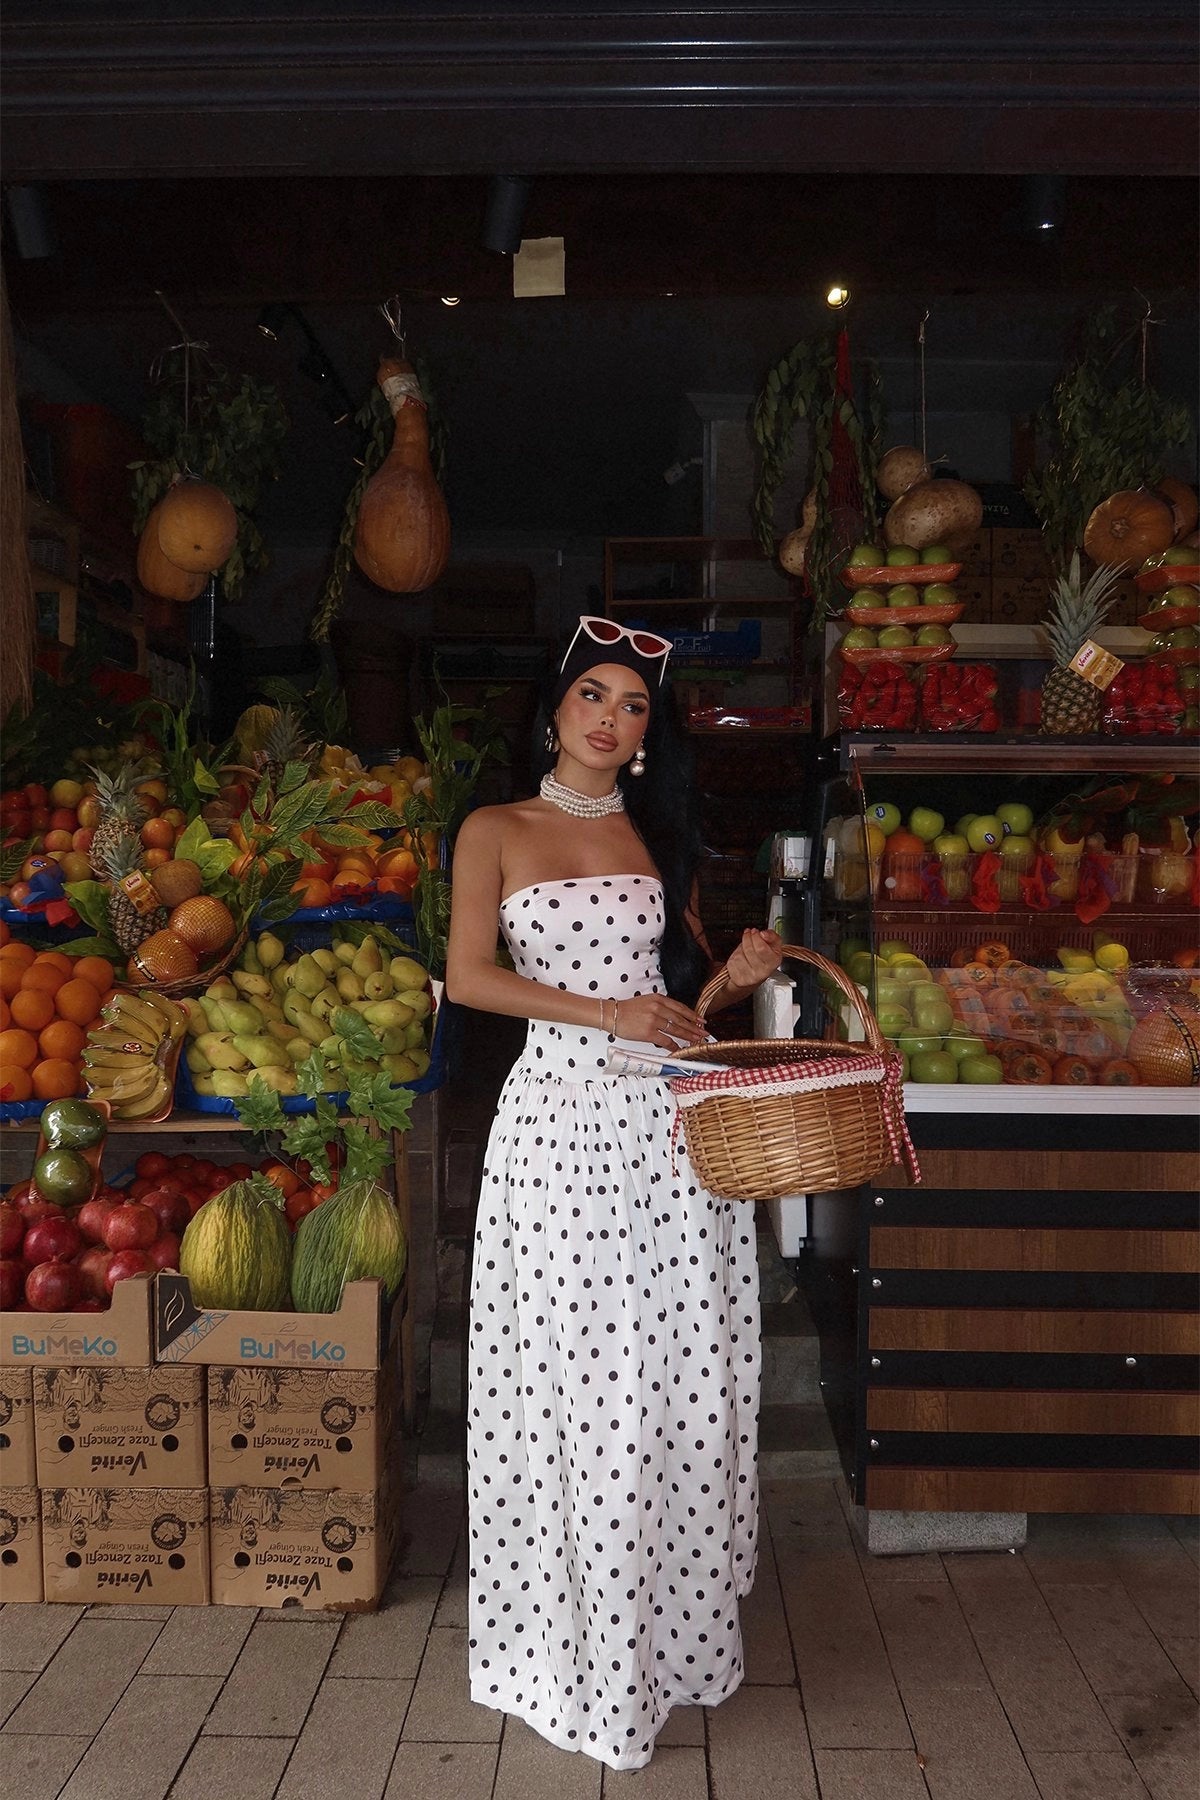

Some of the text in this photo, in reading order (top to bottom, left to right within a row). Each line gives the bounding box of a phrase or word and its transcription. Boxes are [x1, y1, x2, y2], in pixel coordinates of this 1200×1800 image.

[12, 1335, 118, 1356] BuMeKo
[240, 1337, 346, 1361] BuMeKo
[92, 1425, 144, 1433] Fresh Ginger
[266, 1425, 318, 1435] Fresh Ginger
[79, 1433, 158, 1448] Taze Zencefil
[253, 1433, 332, 1449] Taze Zencefil
[98, 1541, 149, 1551] Fresh Ginger
[269, 1544, 319, 1554] Fresh Ginger
[86, 1551, 163, 1565] Taze Zencefil
[255, 1551, 333, 1568] Taze Zencefil
